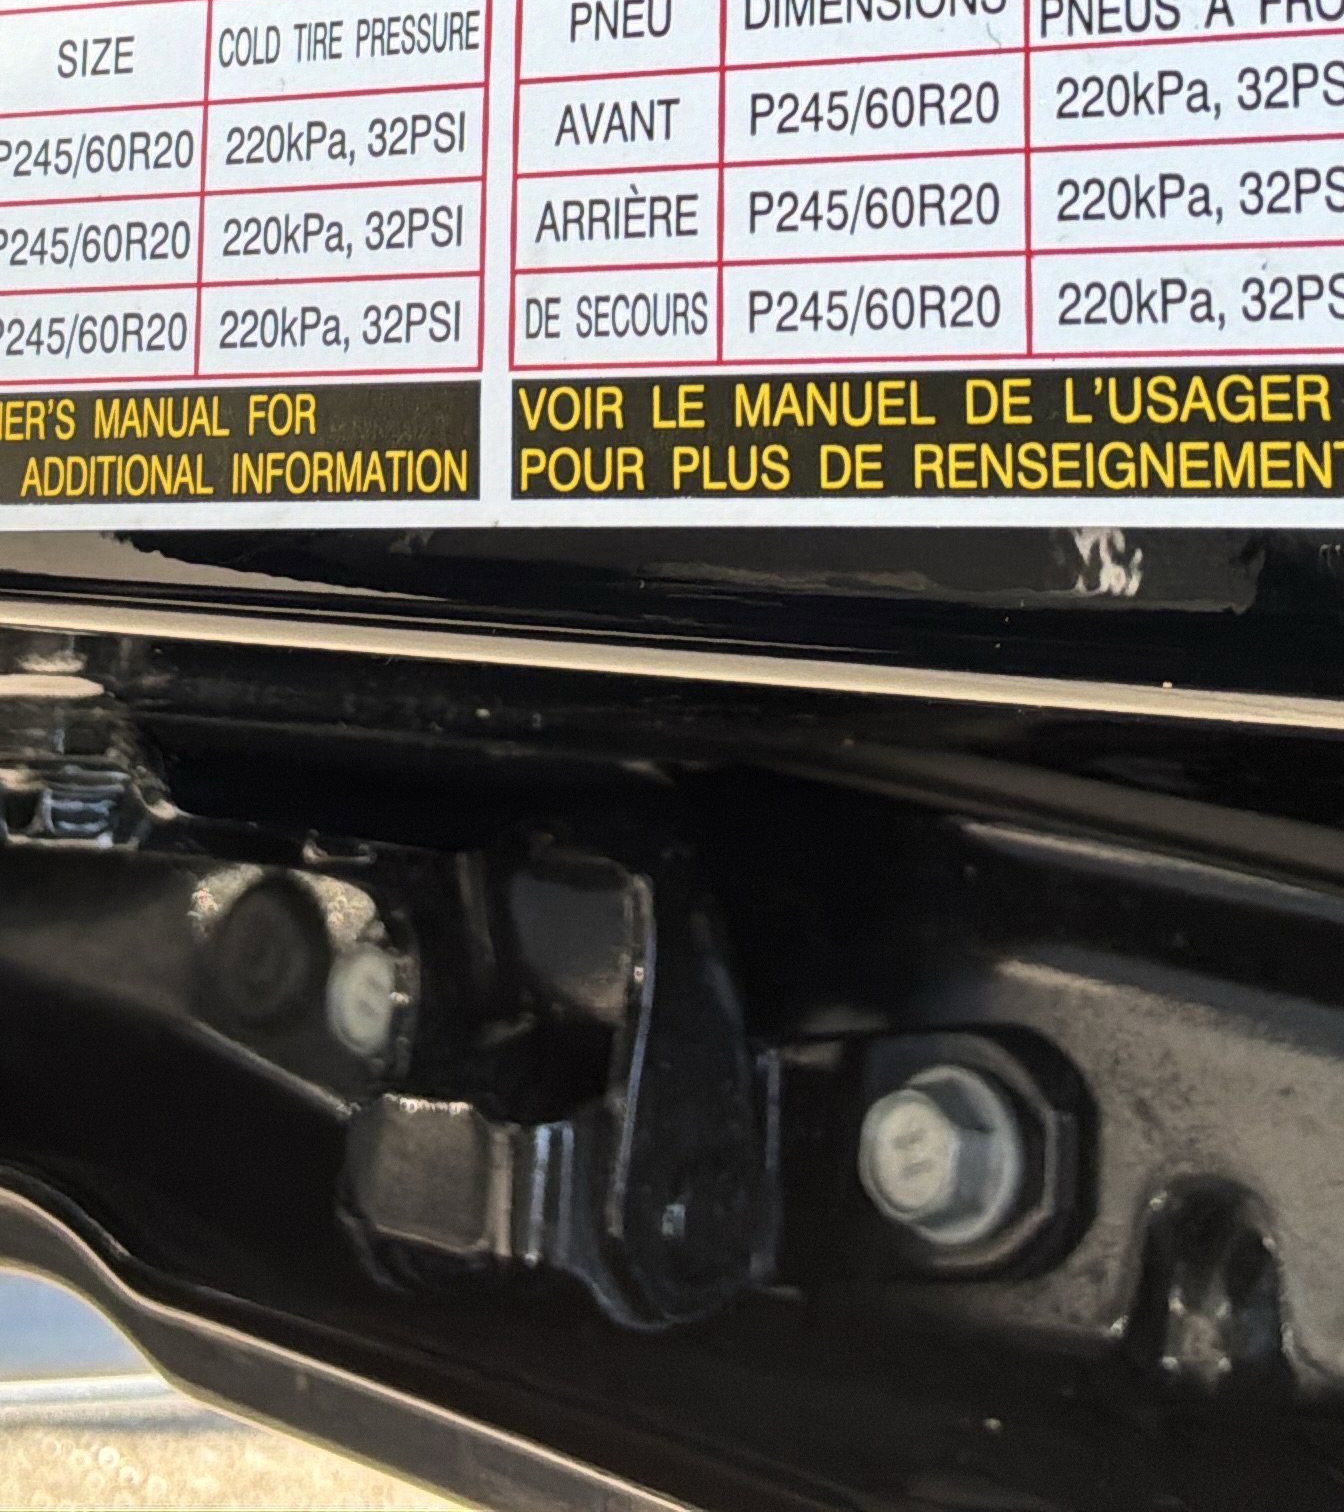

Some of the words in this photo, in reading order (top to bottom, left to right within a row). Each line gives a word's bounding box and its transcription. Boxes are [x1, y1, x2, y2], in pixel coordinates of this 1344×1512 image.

[57, 36, 134, 79] SIZE
[218, 25, 281, 68] COLD
[293, 20, 344, 62] TIRE
[356, 10, 481, 58] PRESSURE
[750, 81, 1000, 136] P245/60R20
[1056, 70, 1221, 120] 220kPa,
[225, 120, 355, 166] 220kPa,
[367, 111, 466, 158] 32PSI
[554, 98, 681, 147] AVANT
[534, 184, 699, 243] ARRIÈRE
[749, 182, 1000, 235] P245/60R20
[1057, 173, 1223, 225] 220kPa,
[222, 212, 353, 259] 220kPa,
[365, 204, 463, 251] 32PSI
[219, 306, 350, 353] 220kPa,
[362, 300, 461, 345] 32PSI
[525, 297, 561, 339] DE
[576, 291, 708, 339] SECOURS
[749, 284, 1001, 336] P245/60R20
[1058, 278, 1226, 330] 220kPa,
[94, 395, 231, 440] MANUAL
[248, 392, 317, 437] FOR
[518, 385, 624, 432] VOIR
[652, 384, 706, 429] LE
[735, 379, 936, 428] MANUEL
[965, 377, 1033, 425] DE
[1065, 374, 1332, 425] L'USAGER
[19, 453, 215, 498] ADDITIONAL
[231, 448, 468, 495] INFORMATION
[520, 446, 645, 493] POUR
[672, 443, 791, 491] PLUS
[819, 443, 884, 490] DE
